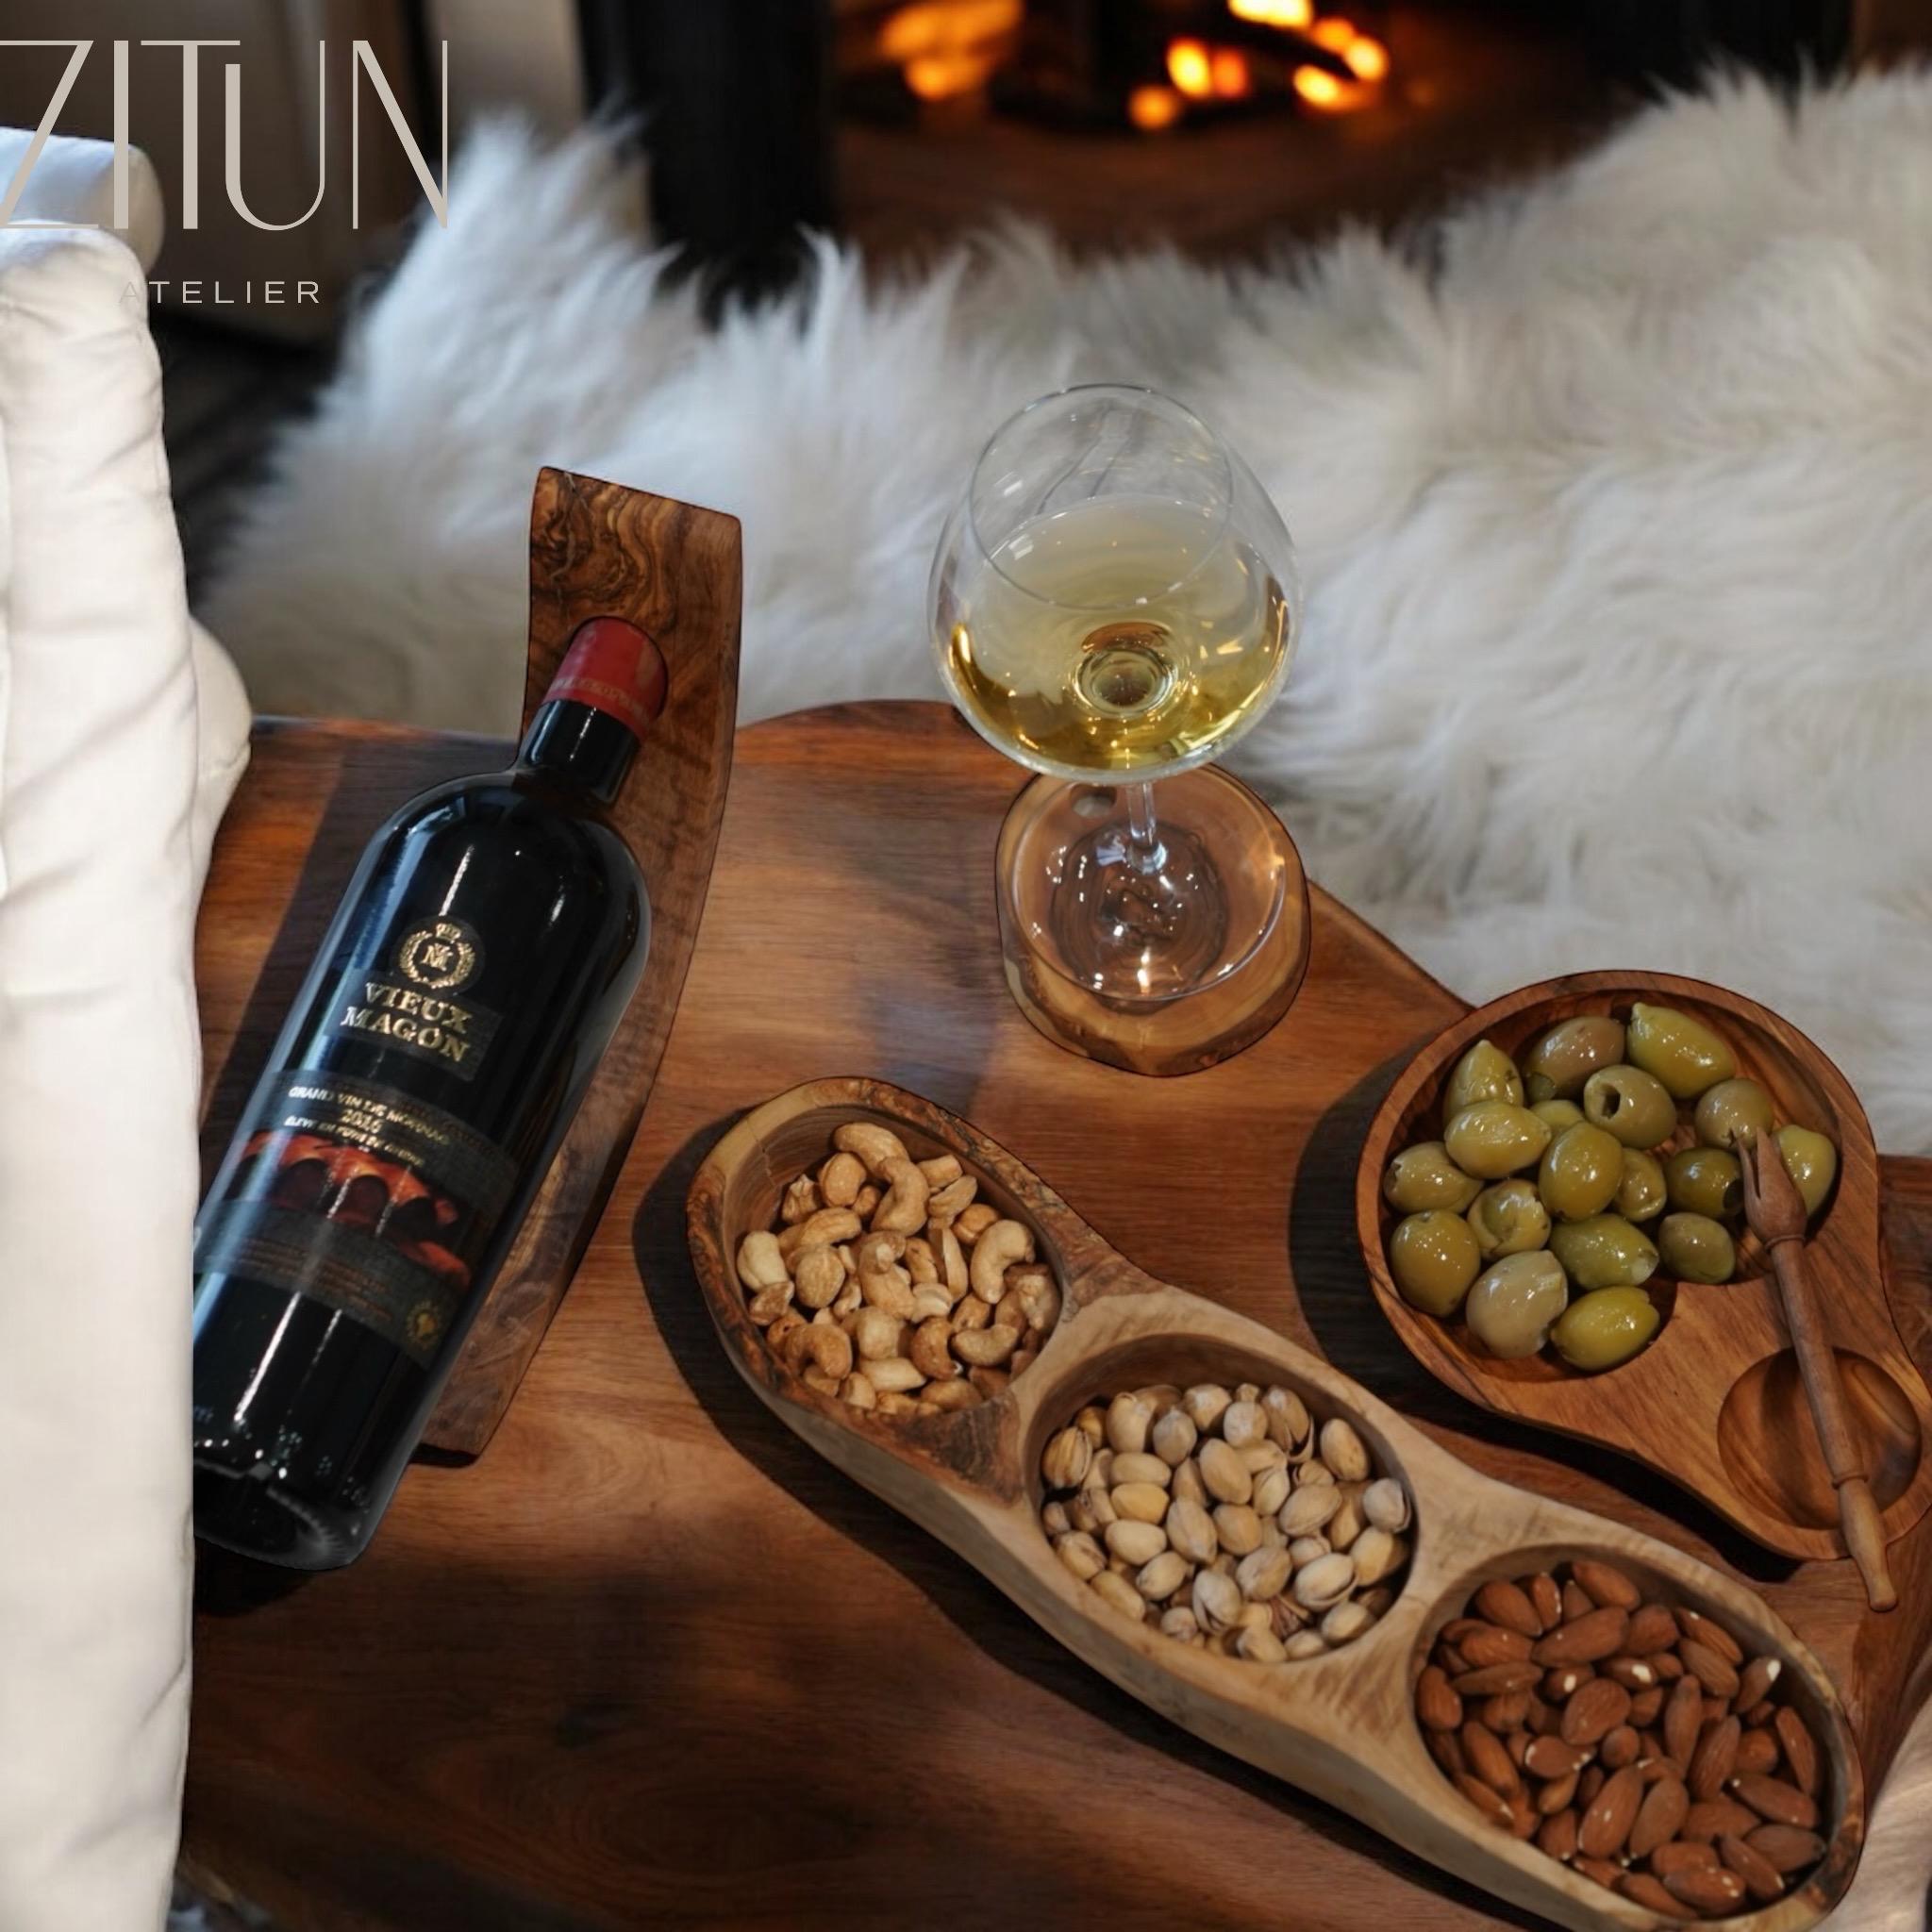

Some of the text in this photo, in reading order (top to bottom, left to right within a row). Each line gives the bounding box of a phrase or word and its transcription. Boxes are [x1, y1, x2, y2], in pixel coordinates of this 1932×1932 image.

[340, 1006, 471, 1061] MAGON
[365, 982, 472, 1034] VIEUX
[288, 1086, 334, 1101] GRAND
[338, 1092, 363, 1108] VIN
